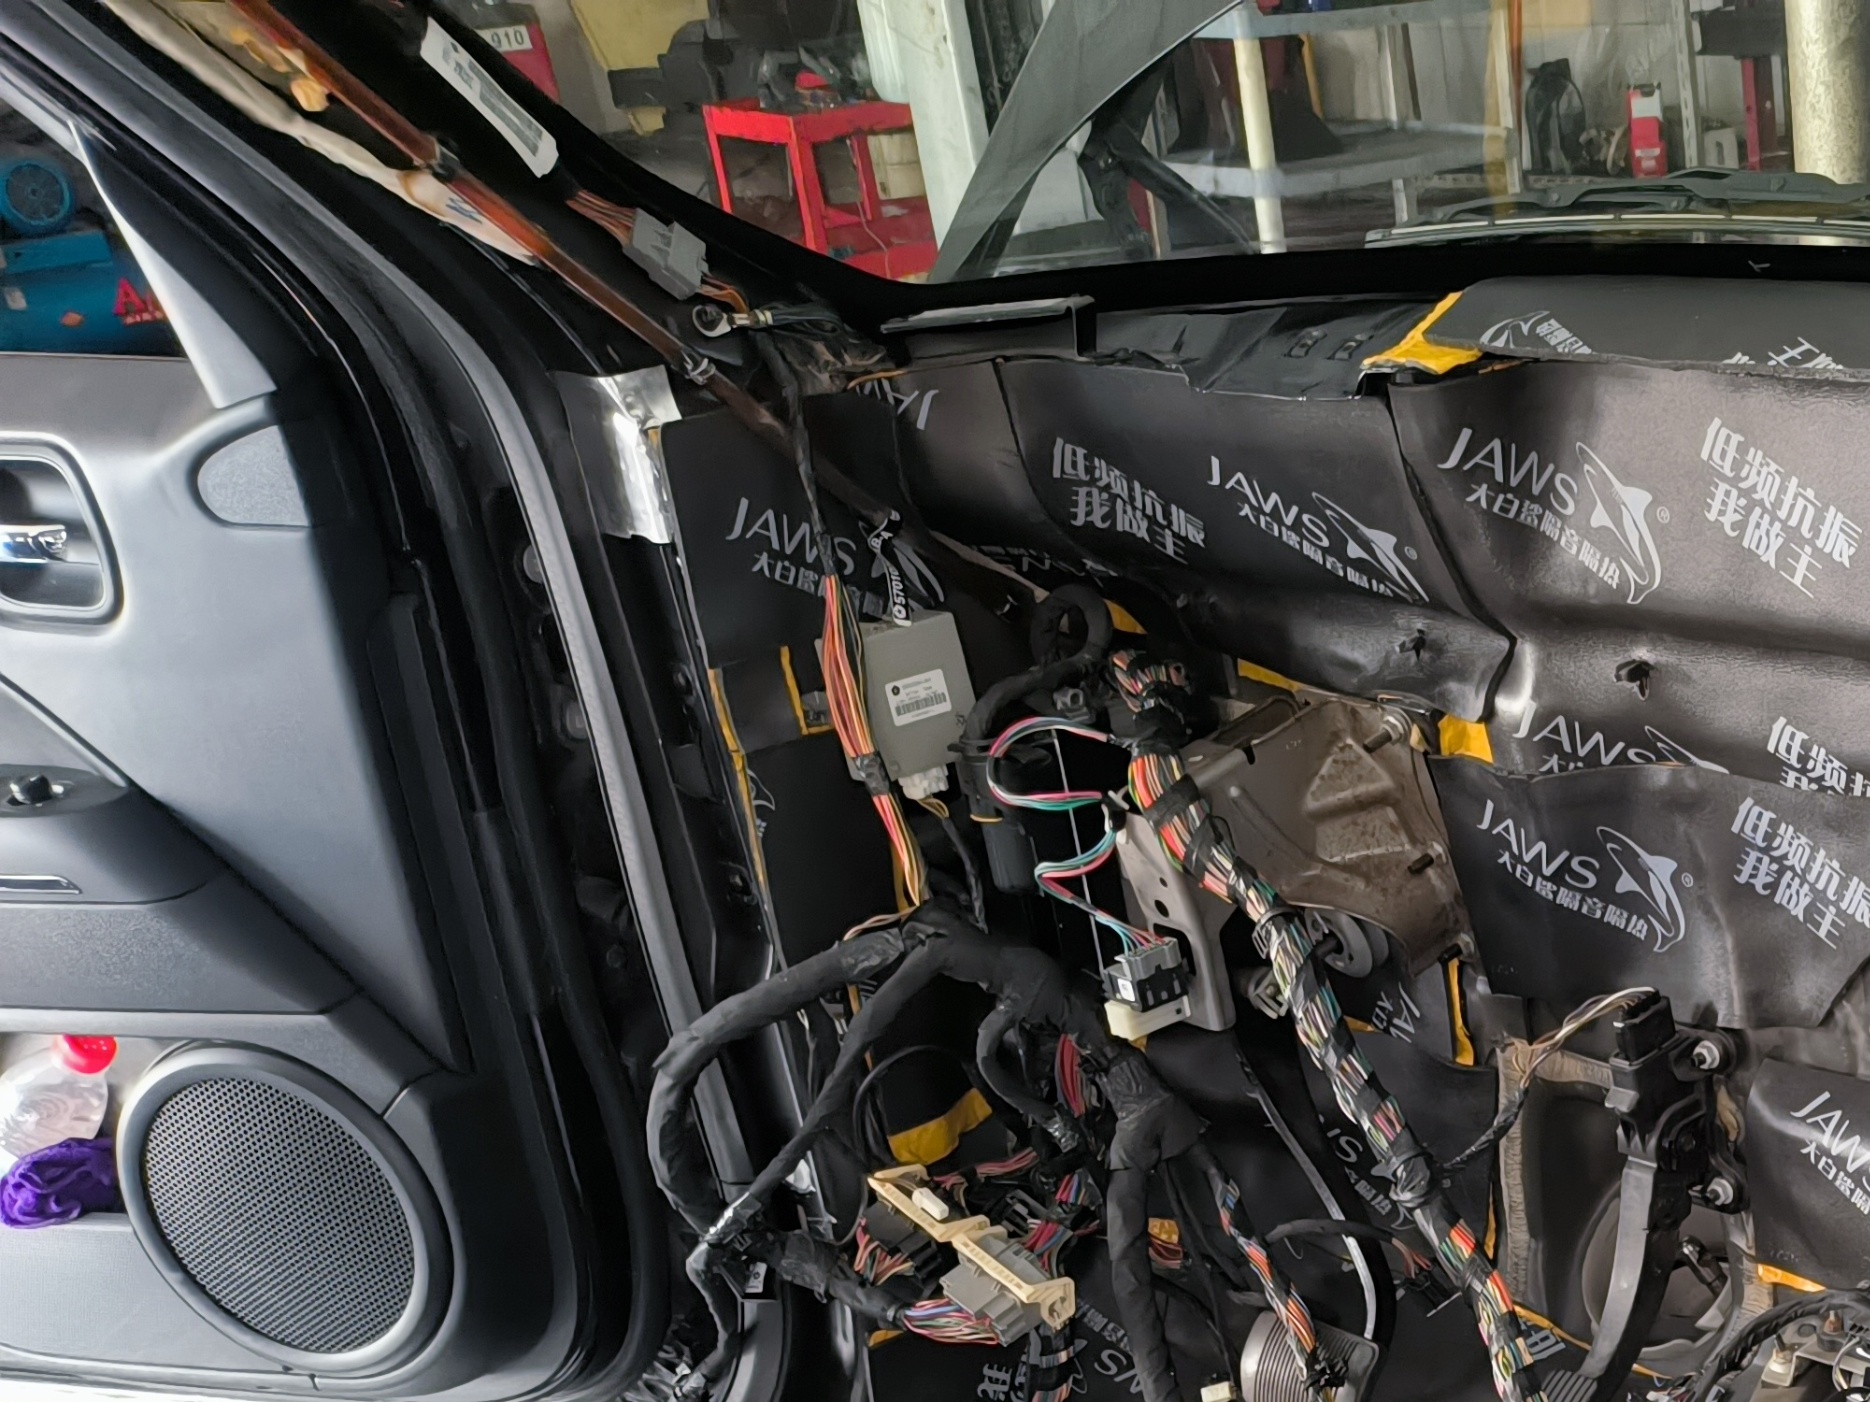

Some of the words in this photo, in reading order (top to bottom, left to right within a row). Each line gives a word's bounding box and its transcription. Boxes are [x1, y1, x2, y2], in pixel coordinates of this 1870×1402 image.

[1052, 438, 1205, 550] 低频抗振
[1208, 455, 1328, 547] JAWS
[1439, 428, 1579, 515] JAWS
[1701, 417, 1862, 568] 低频抗振
[1070, 484, 1192, 564] 我做主
[1706, 478, 1818, 599] 我做主
[1476, 798, 1601, 891] JAWS
[1734, 846, 1848, 951] 我做主
